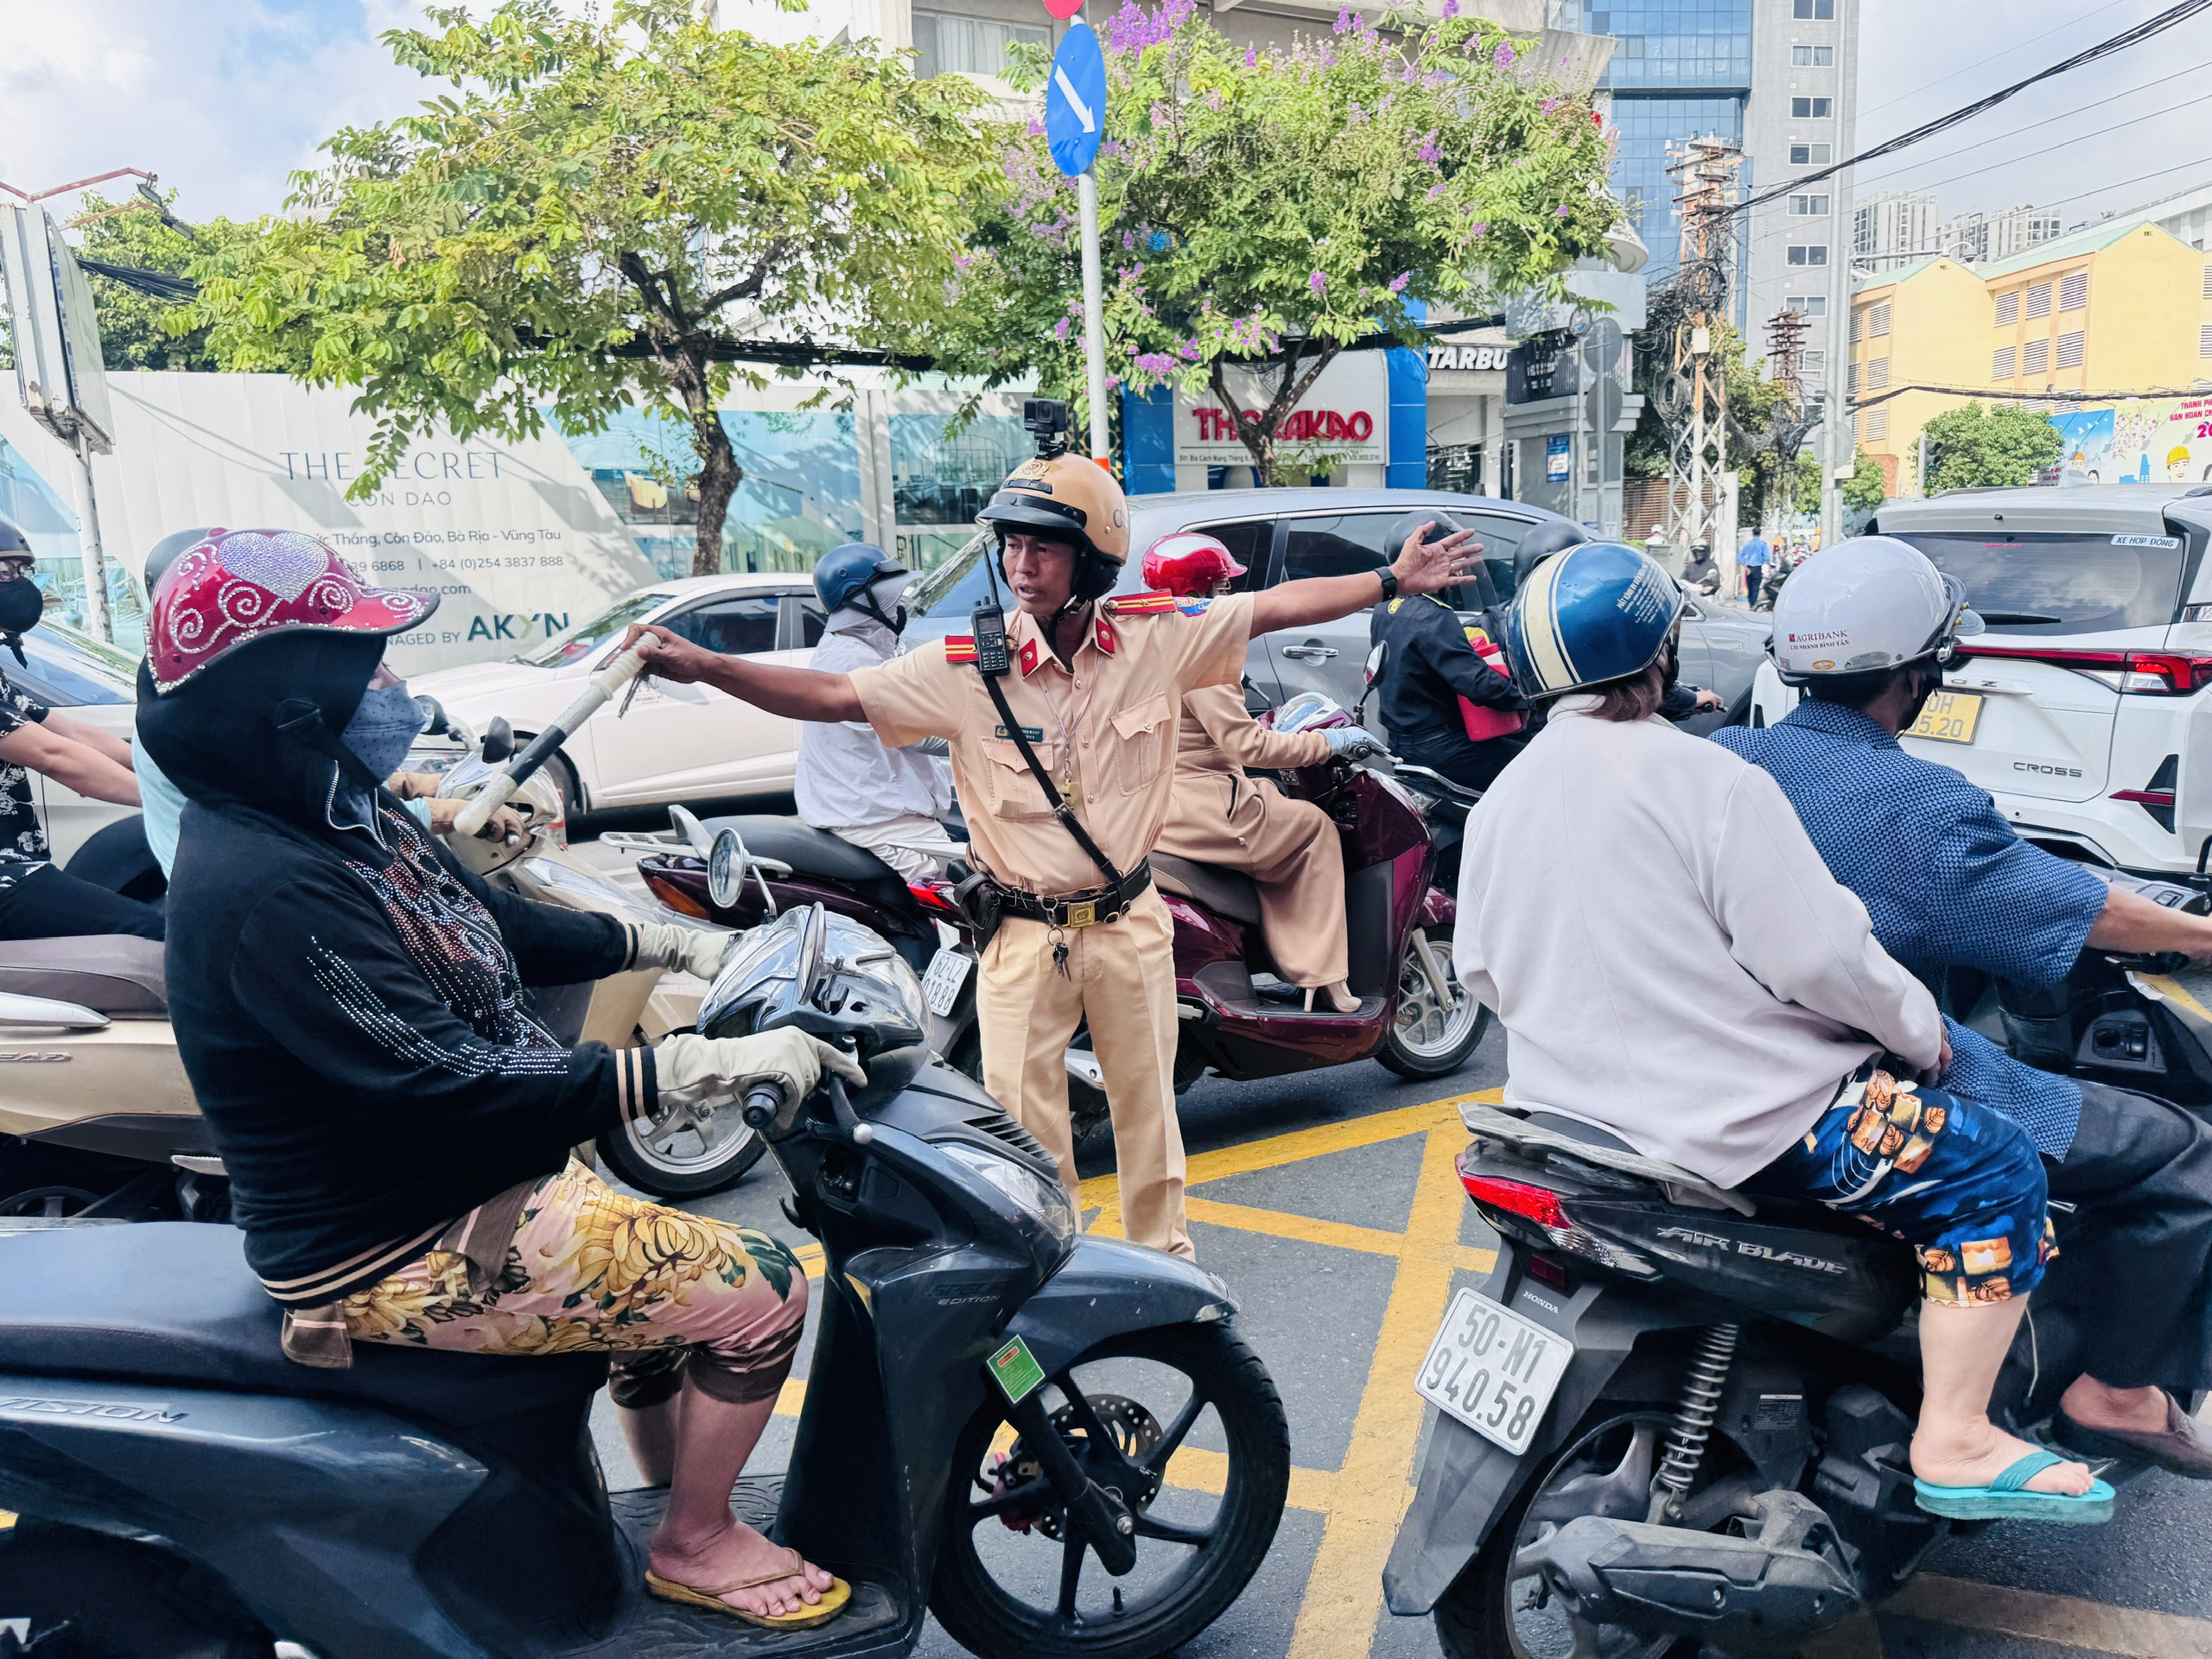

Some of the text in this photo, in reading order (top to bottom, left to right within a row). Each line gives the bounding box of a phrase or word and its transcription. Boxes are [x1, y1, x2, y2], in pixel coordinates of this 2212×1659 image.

[1427, 346, 1510, 370] TARBU
[1192, 408, 1373, 442] THAKAO
[279, 452, 504, 480] THE ECRET
[406, 491, 452, 505] DAO
[448, 528, 465, 541] Bà
[469, 529, 490, 543] Rịa
[501, 529, 535, 543] Vũng
[537, 528, 562, 541] Tàu
[372, 560, 404, 571] 6868
[431, 556, 563, 570] +84 (0)254 3837 888
[467, 612, 569, 642] AKYN
[1796, 630, 1848, 642] AGRIBANK
[442, 632, 461, 644] BY
[2013, 761, 2082, 778] CROSS
[1657, 1226, 1847, 1274] AIR BLADE
[938, 1295, 1001, 1306] EDITION
[1522, 1291, 1560, 1314] HONDA
[1458, 1303, 1549, 1383] 50-N1
[1426, 1347, 1537, 1442] 940.58
